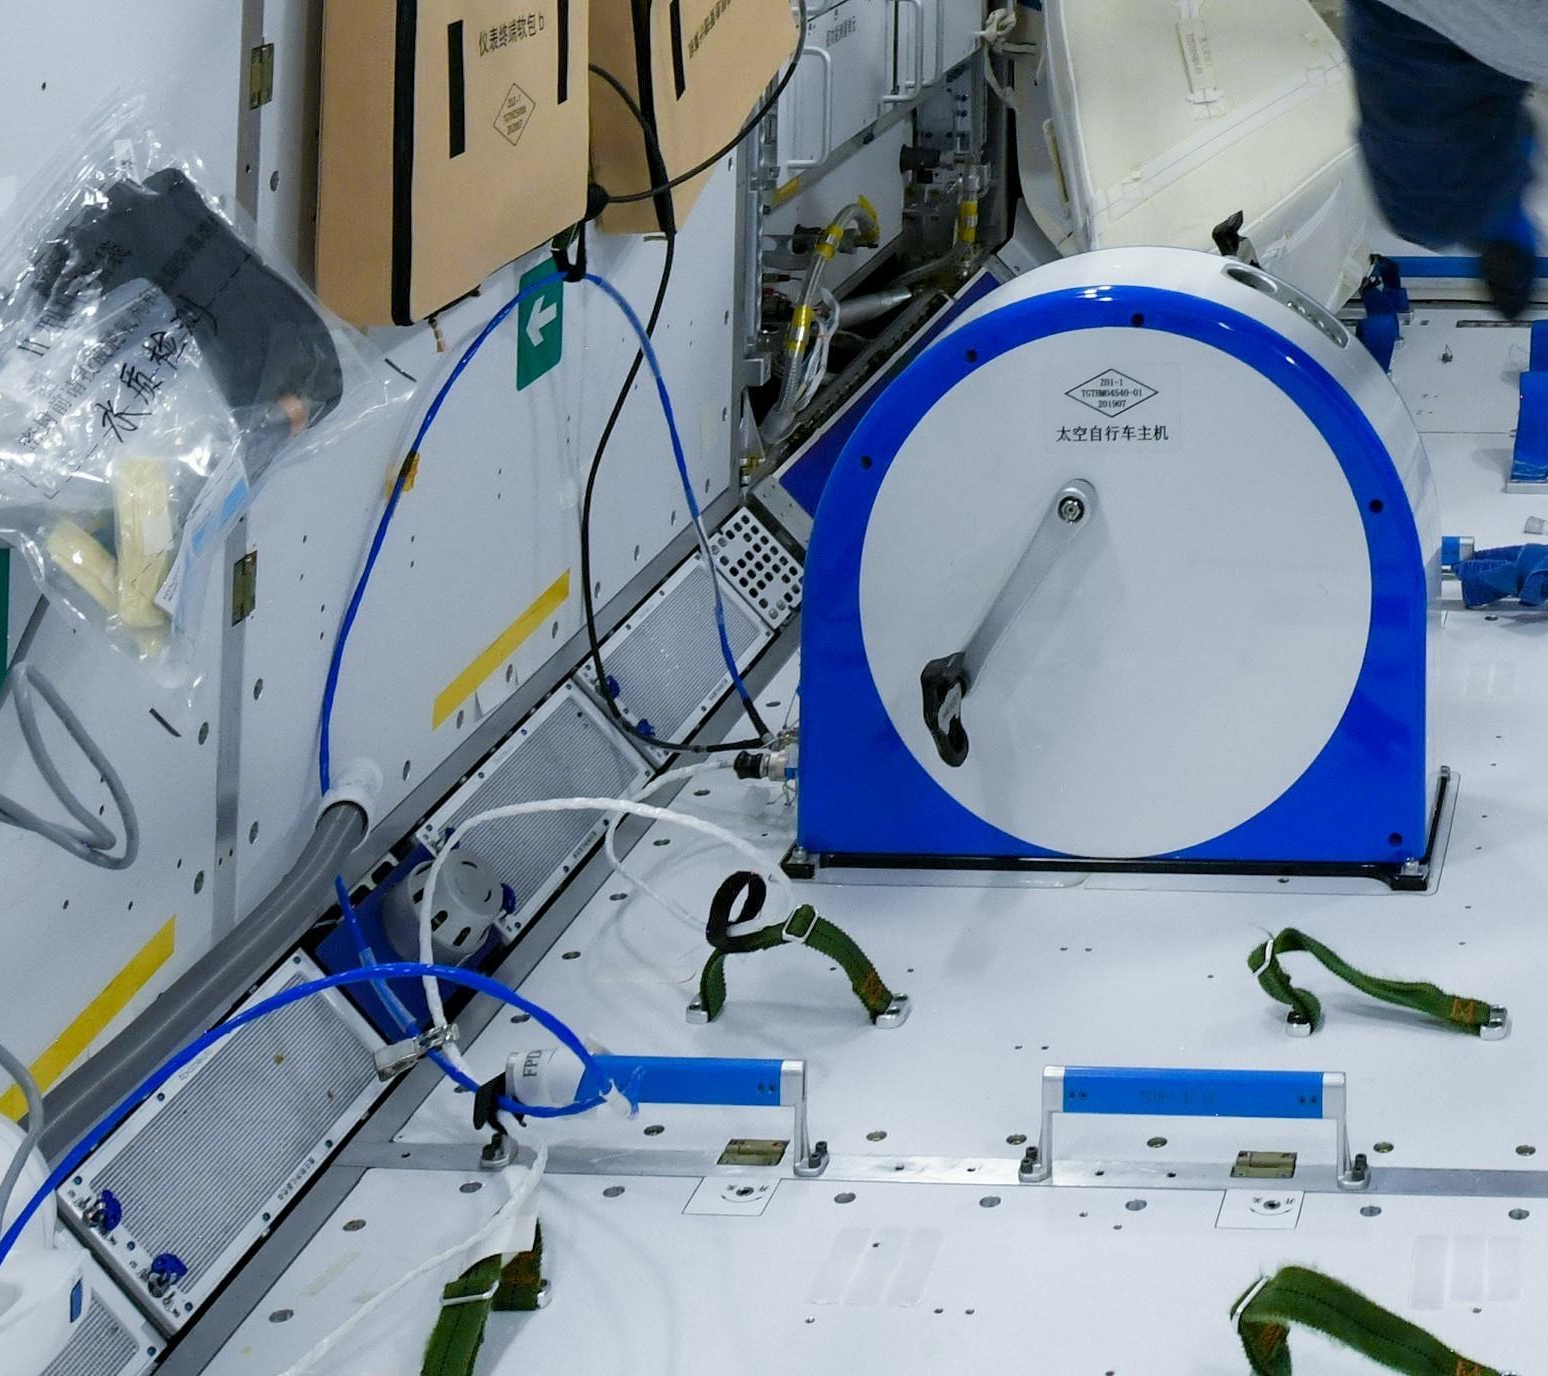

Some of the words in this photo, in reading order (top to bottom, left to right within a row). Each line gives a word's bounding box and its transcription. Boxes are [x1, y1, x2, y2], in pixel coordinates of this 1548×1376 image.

[478, 14, 535, 57] 仪表终端软包
[1099, 378, 1124, 387] Z01-1
[1097, 400, 1127, 408] 201907
[1056, 424, 1169, 443] 太空自行车主机
